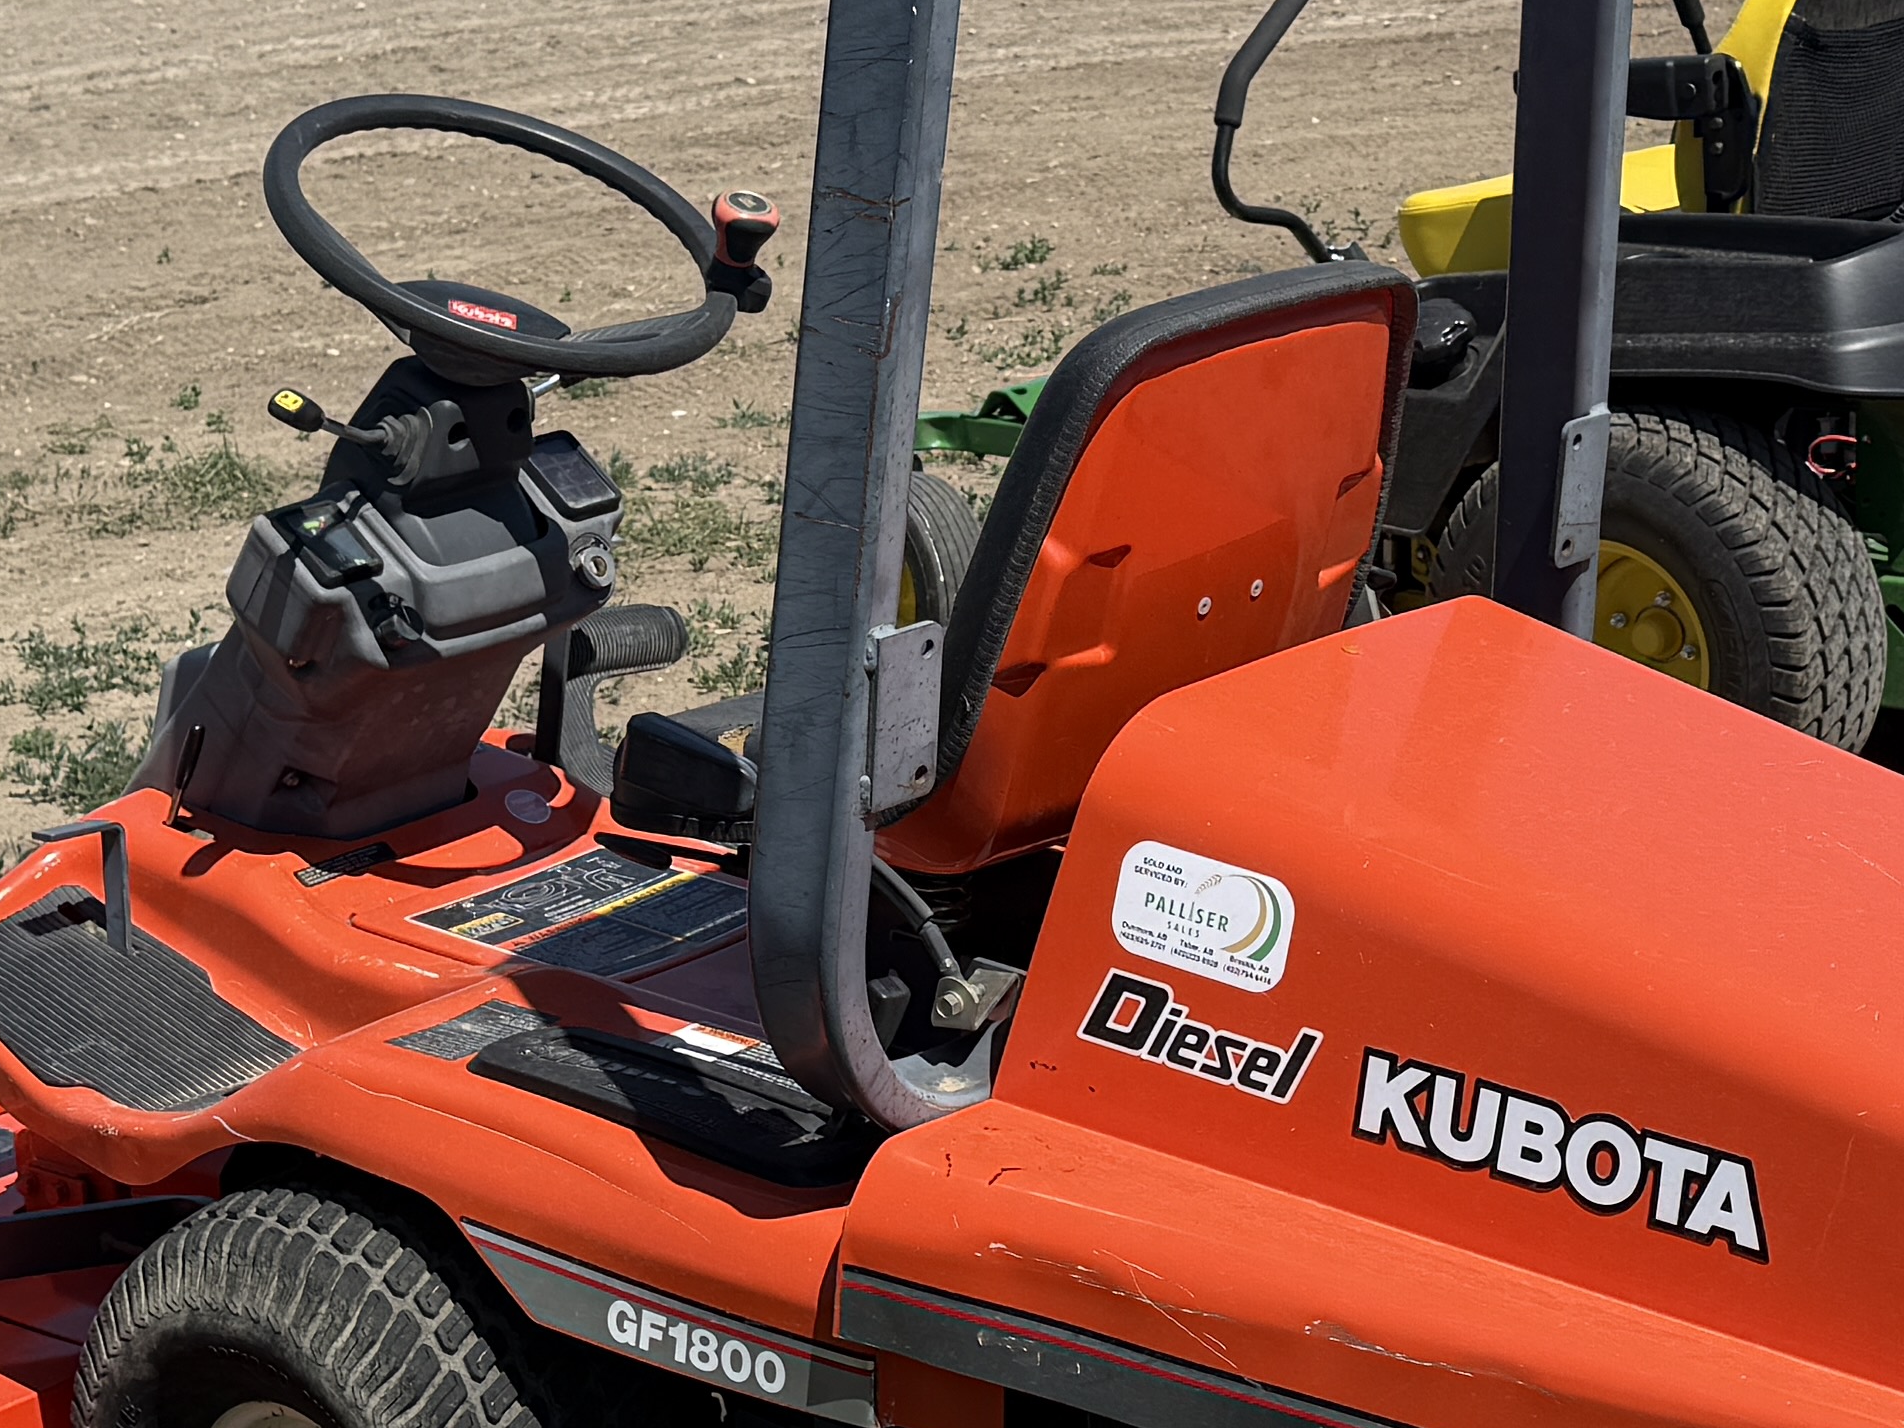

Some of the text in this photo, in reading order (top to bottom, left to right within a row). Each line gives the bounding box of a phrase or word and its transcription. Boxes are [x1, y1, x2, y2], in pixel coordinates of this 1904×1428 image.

[452, 301, 513, 328] Kubota
[1144, 891, 1230, 932] PALLISER
[1167, 921, 1200, 939] SALES
[1081, 971, 1319, 1101] Diesel
[1355, 1051, 1764, 1258] KUBOTA
[606, 1299, 787, 1394] GF1800
